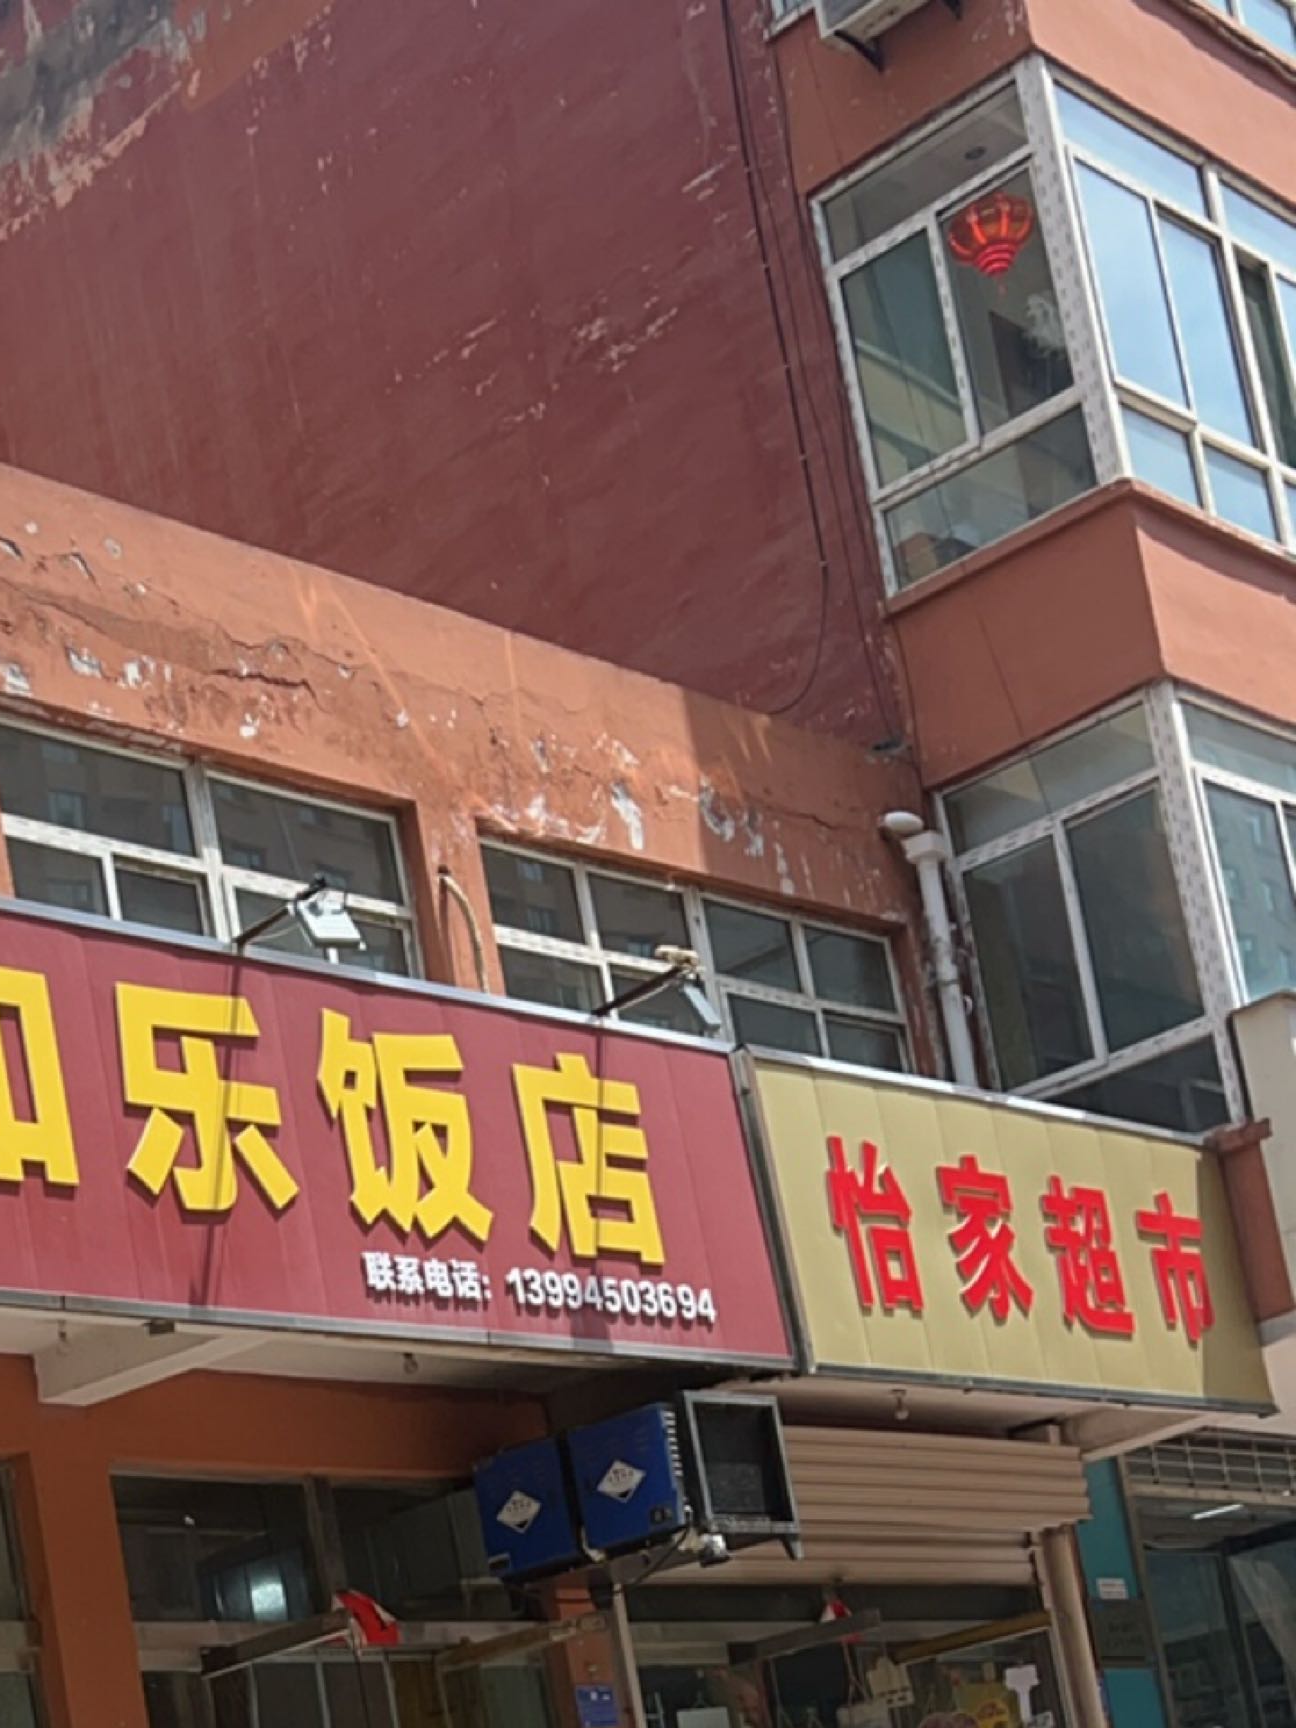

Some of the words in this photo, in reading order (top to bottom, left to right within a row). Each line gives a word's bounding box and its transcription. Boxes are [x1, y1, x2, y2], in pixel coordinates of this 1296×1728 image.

[506, 1267, 716, 1324] 13994503694
[826, 1135, 1215, 1343] 怡家超市
